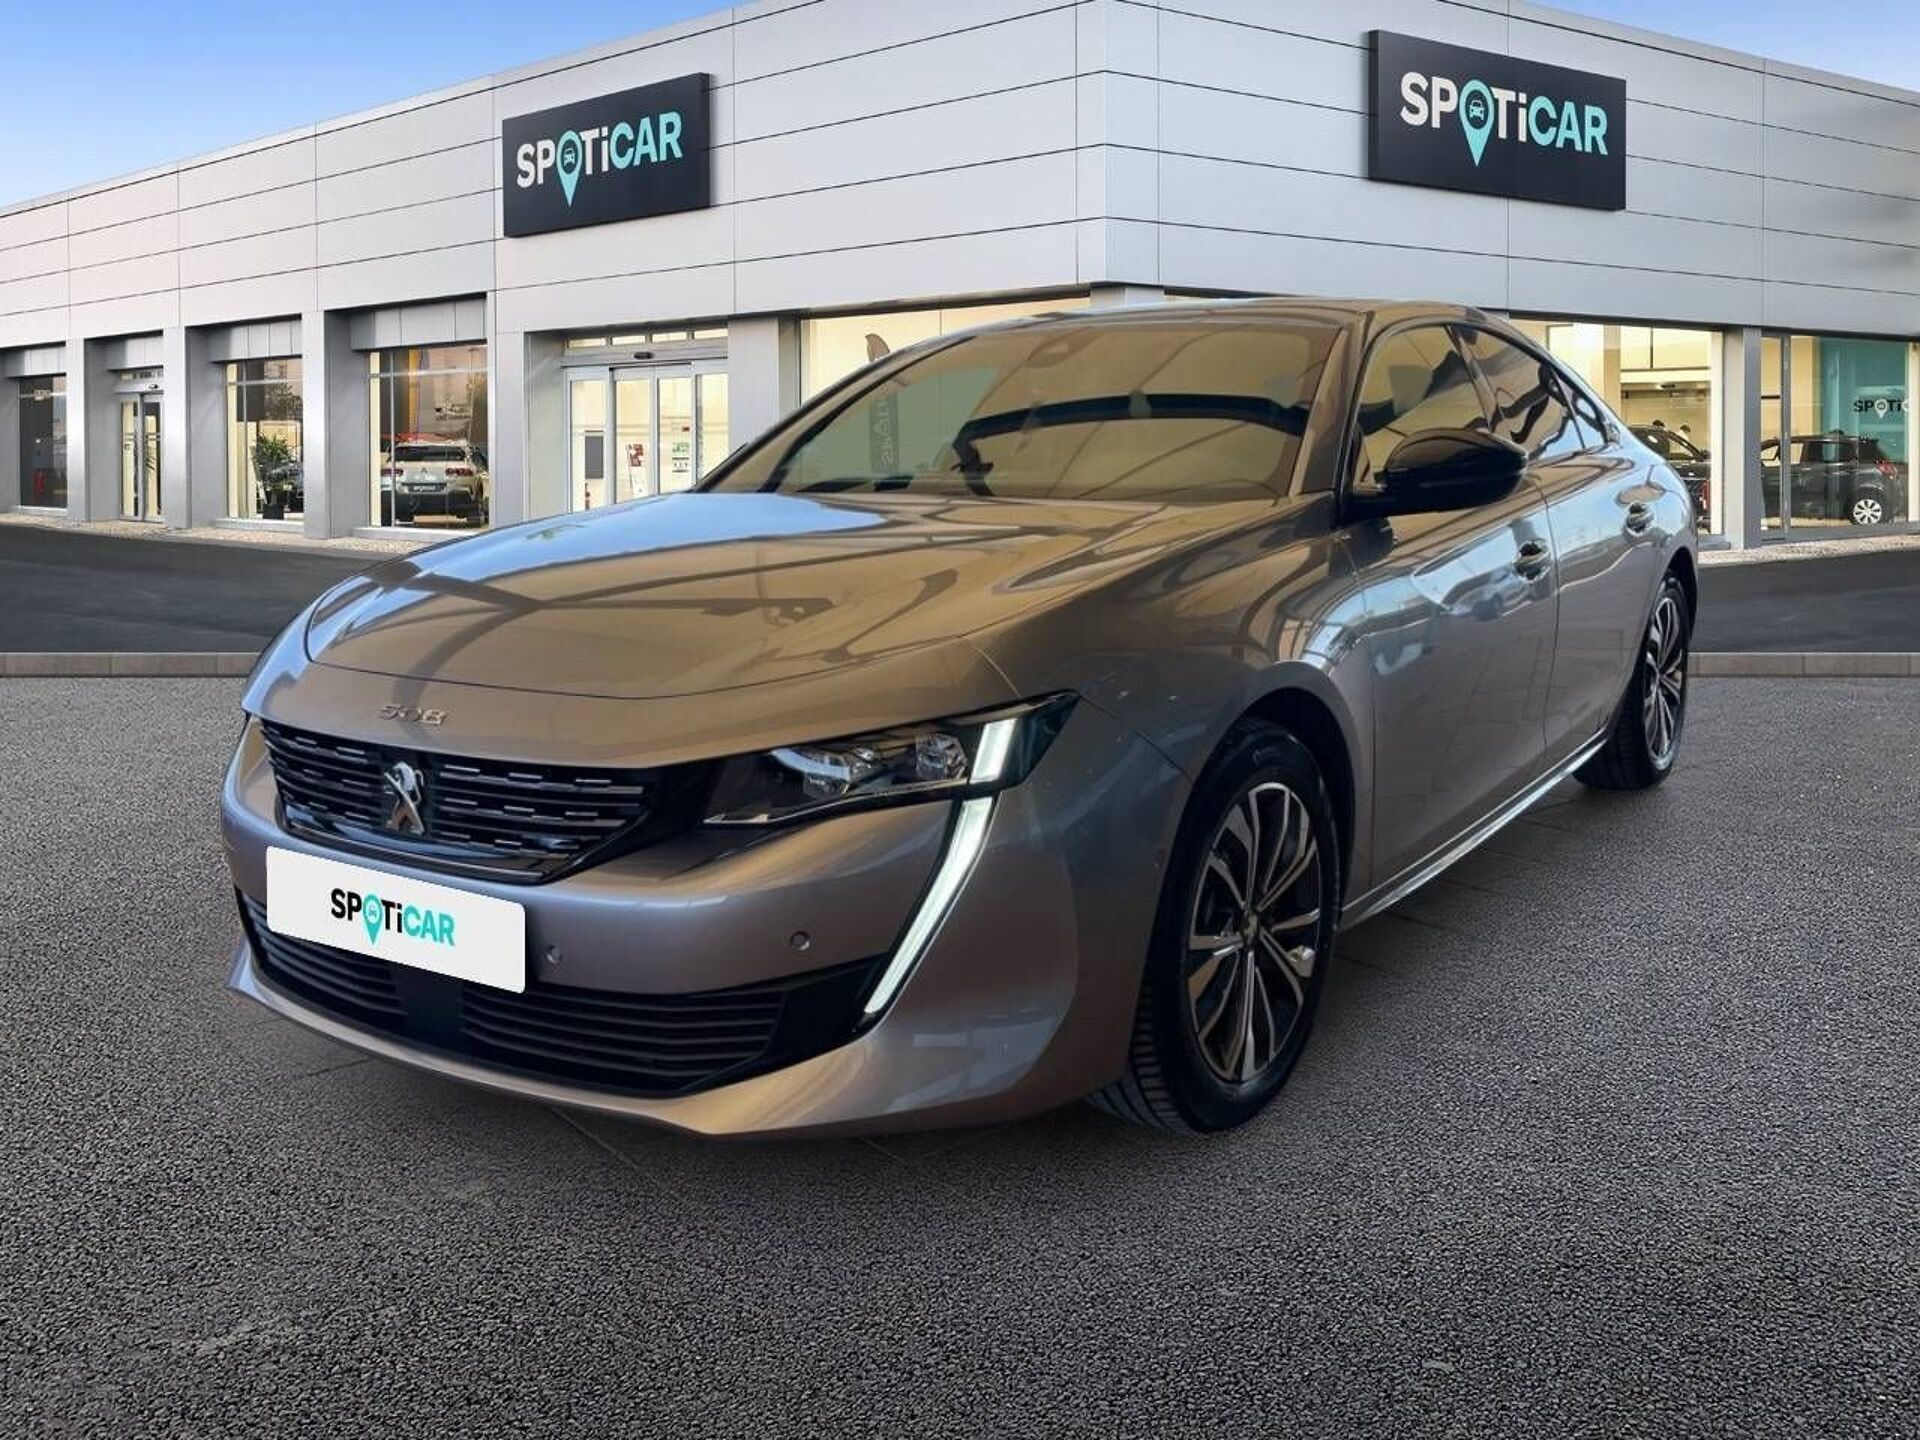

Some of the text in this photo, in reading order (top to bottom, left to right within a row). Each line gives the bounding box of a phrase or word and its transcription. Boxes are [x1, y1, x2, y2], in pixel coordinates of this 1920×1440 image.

[516, 111, 683, 207] SPOTiCAR
[1400, 71, 1608, 167] SPOTiCAR
[330, 888, 455, 946] SPOTiCAR
